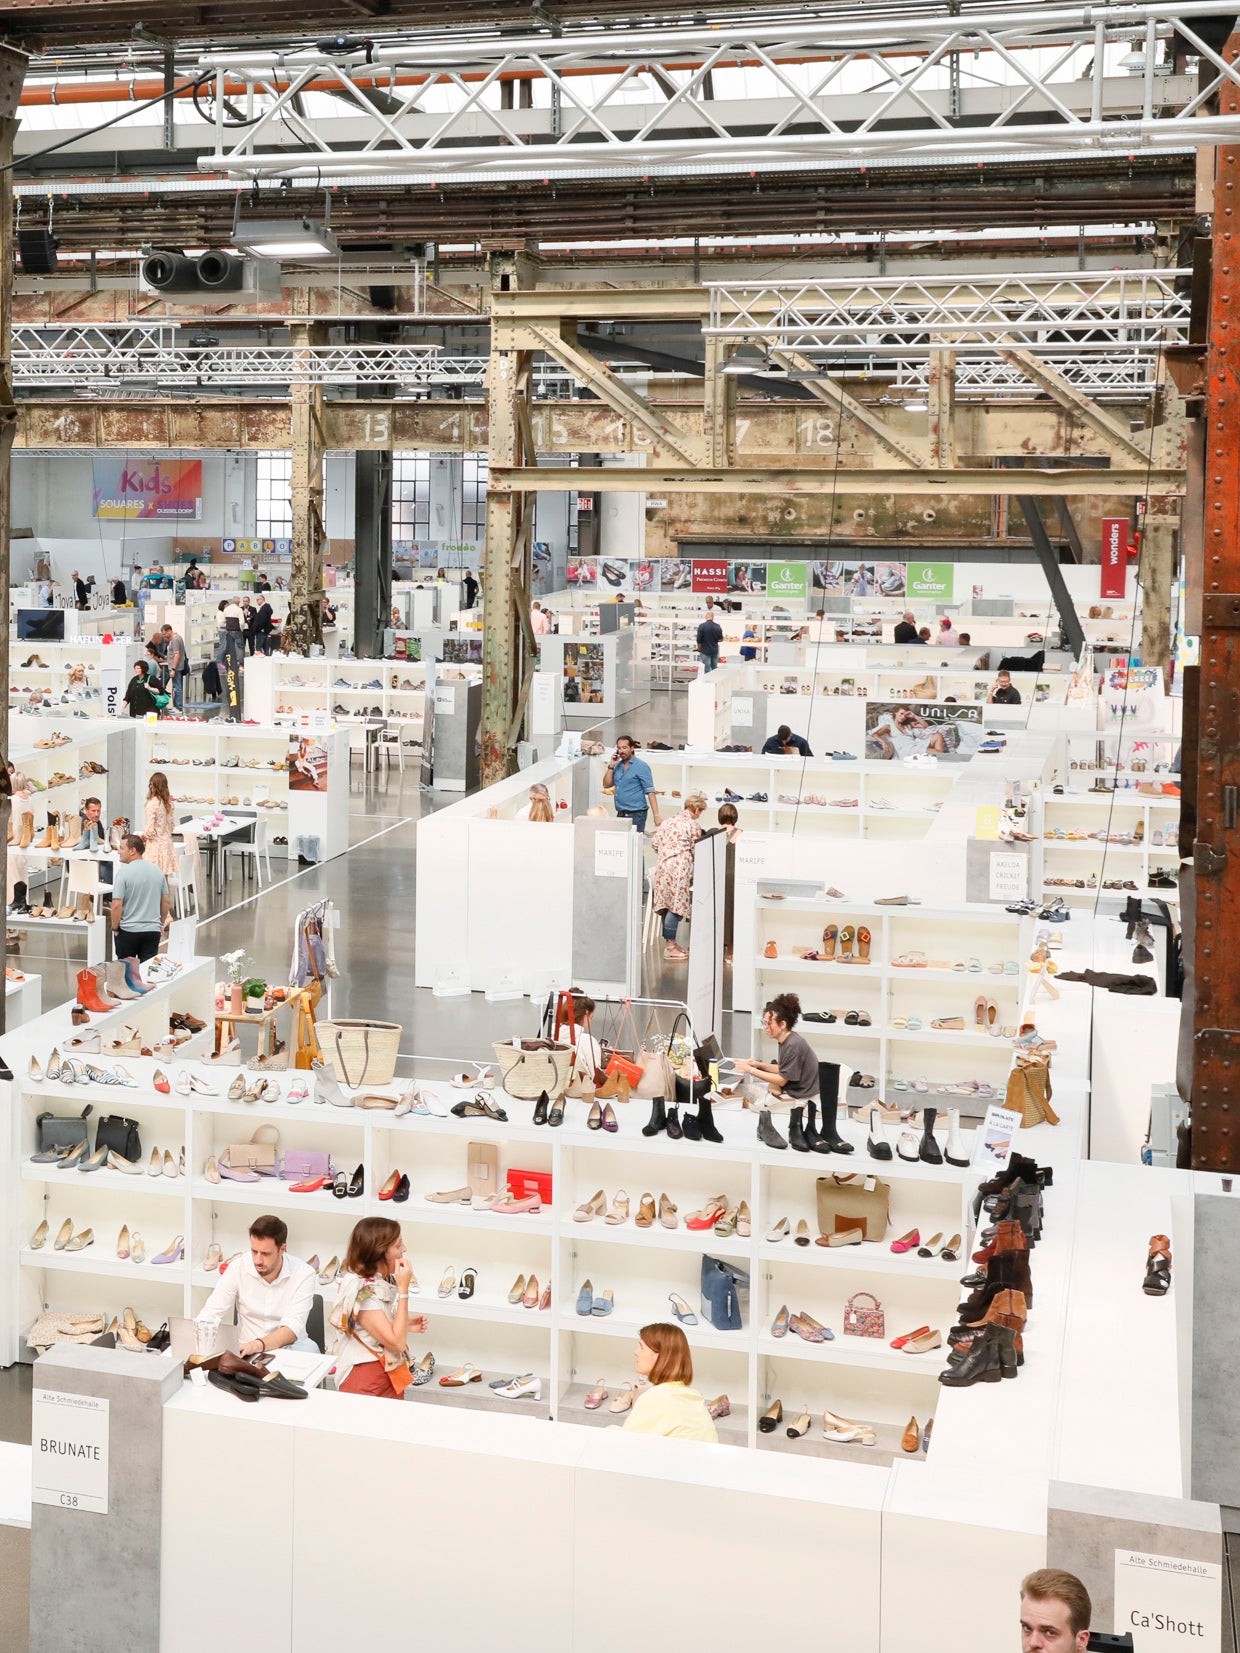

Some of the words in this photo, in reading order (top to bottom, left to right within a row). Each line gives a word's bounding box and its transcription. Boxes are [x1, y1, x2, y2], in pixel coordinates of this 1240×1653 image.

[365, 413, 388, 442] 13
[531, 414, 568, 446] 15
[797, 418, 834, 447] 18
[121, 466, 172, 494] Kids
[1109, 523, 1120, 566] wonders
[771, 581, 804, 590] Ganter
[913, 582, 947, 590] Ganter
[107, 686, 118, 717] Pols
[42, 1393, 55, 1401] Alte
[56, 1395, 99, 1409] Schmiedehalle
[40, 1438, 101, 1461] BRUNATE
[60, 1493, 79, 1507] C38
[1129, 1555, 1146, 1565] Alte
[1148, 1558, 1208, 1575] Schmiedehalle
[1130, 1610, 1205, 1637] Ca'Shott
